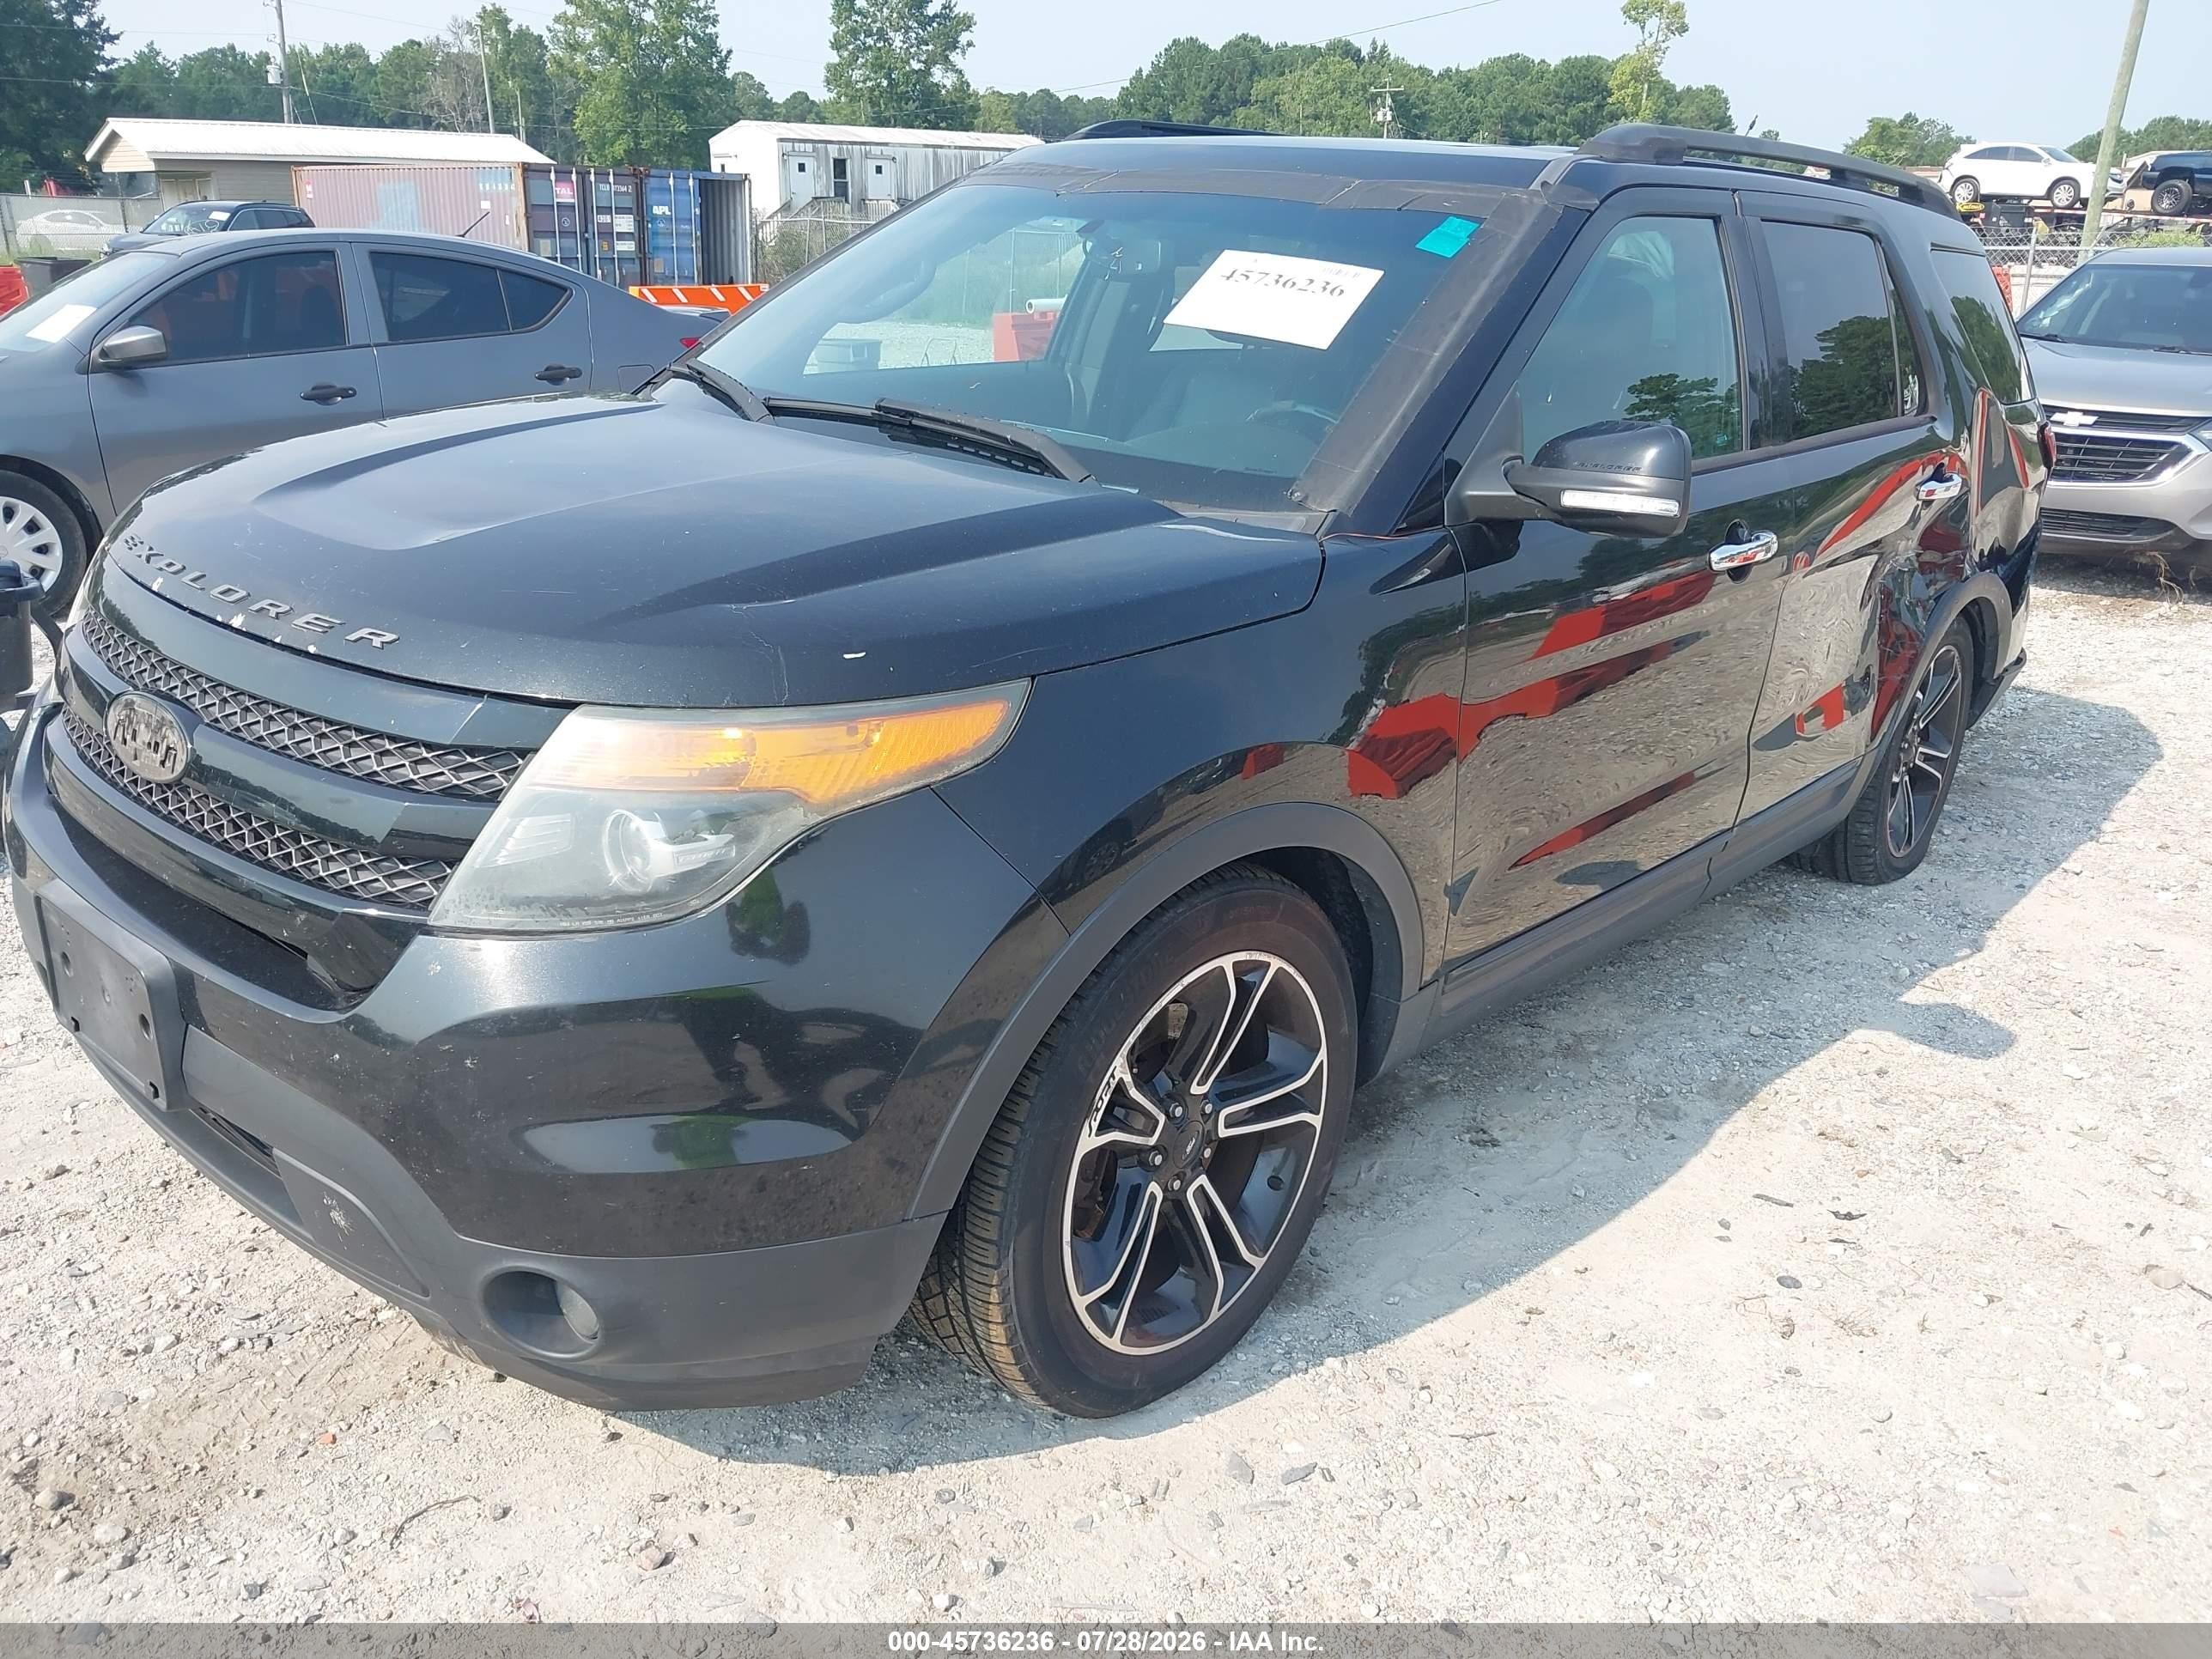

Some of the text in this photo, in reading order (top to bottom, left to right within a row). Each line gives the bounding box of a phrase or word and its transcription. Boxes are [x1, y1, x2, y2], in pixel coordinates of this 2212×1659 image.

[653, 205, 672, 216] APL
[1220, 268, 1345, 297] 45736236
[124, 534, 400, 649] EXPLORER
